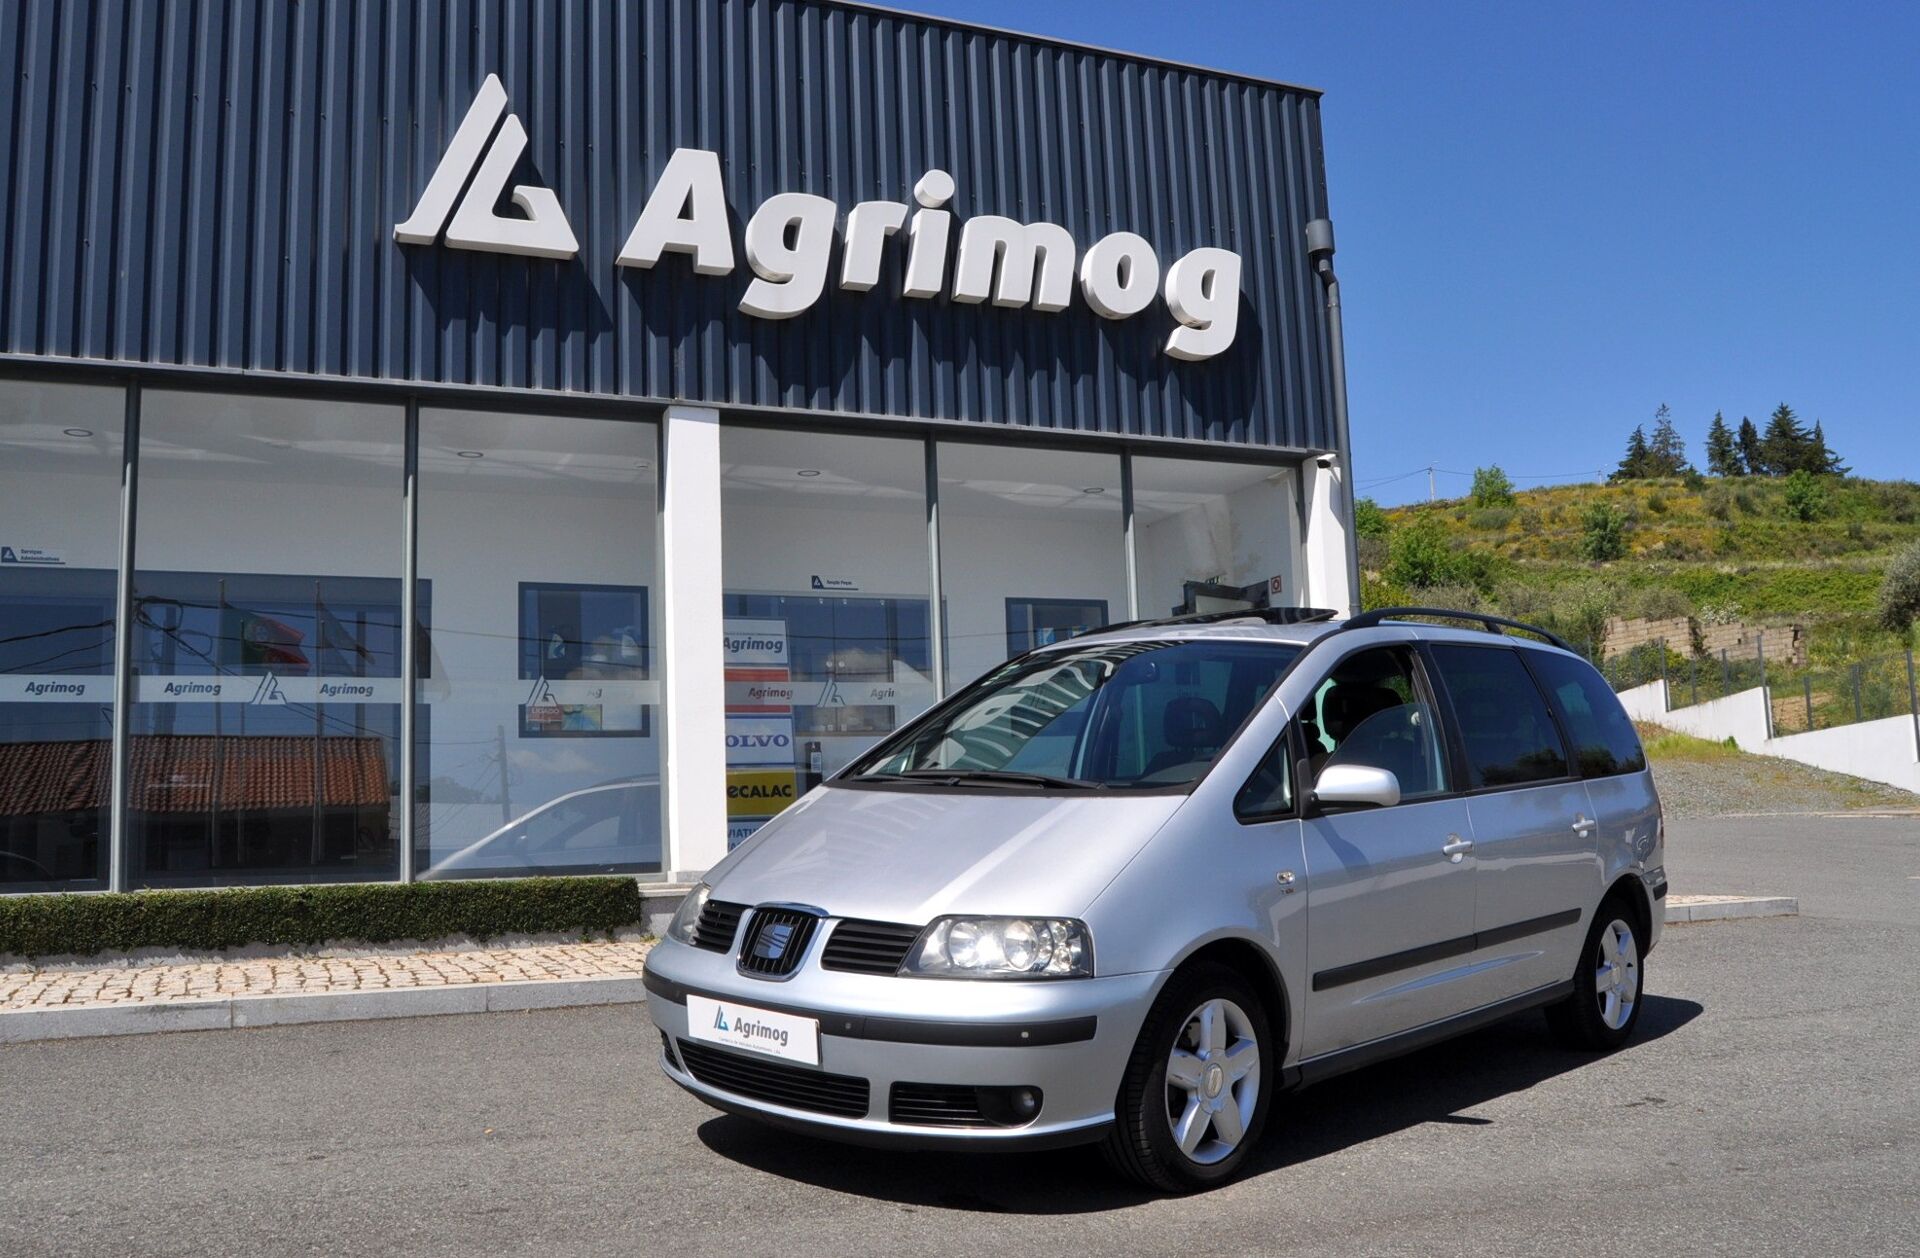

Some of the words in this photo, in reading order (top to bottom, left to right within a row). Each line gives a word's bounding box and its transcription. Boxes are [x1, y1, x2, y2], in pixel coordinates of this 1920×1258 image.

[616, 148, 1242, 362] Agrimog
[723, 636, 783, 653] Agrimog
[25, 681, 86, 697] Agrimog
[164, 681, 222, 697] Agrimog
[319, 682, 374, 698] Agrimog
[748, 687, 793, 700] Agrimog
[725, 734, 789, 748] OLVO
[727, 784, 792, 798] eCALAC
[733, 1017, 789, 1047] Agrimog
